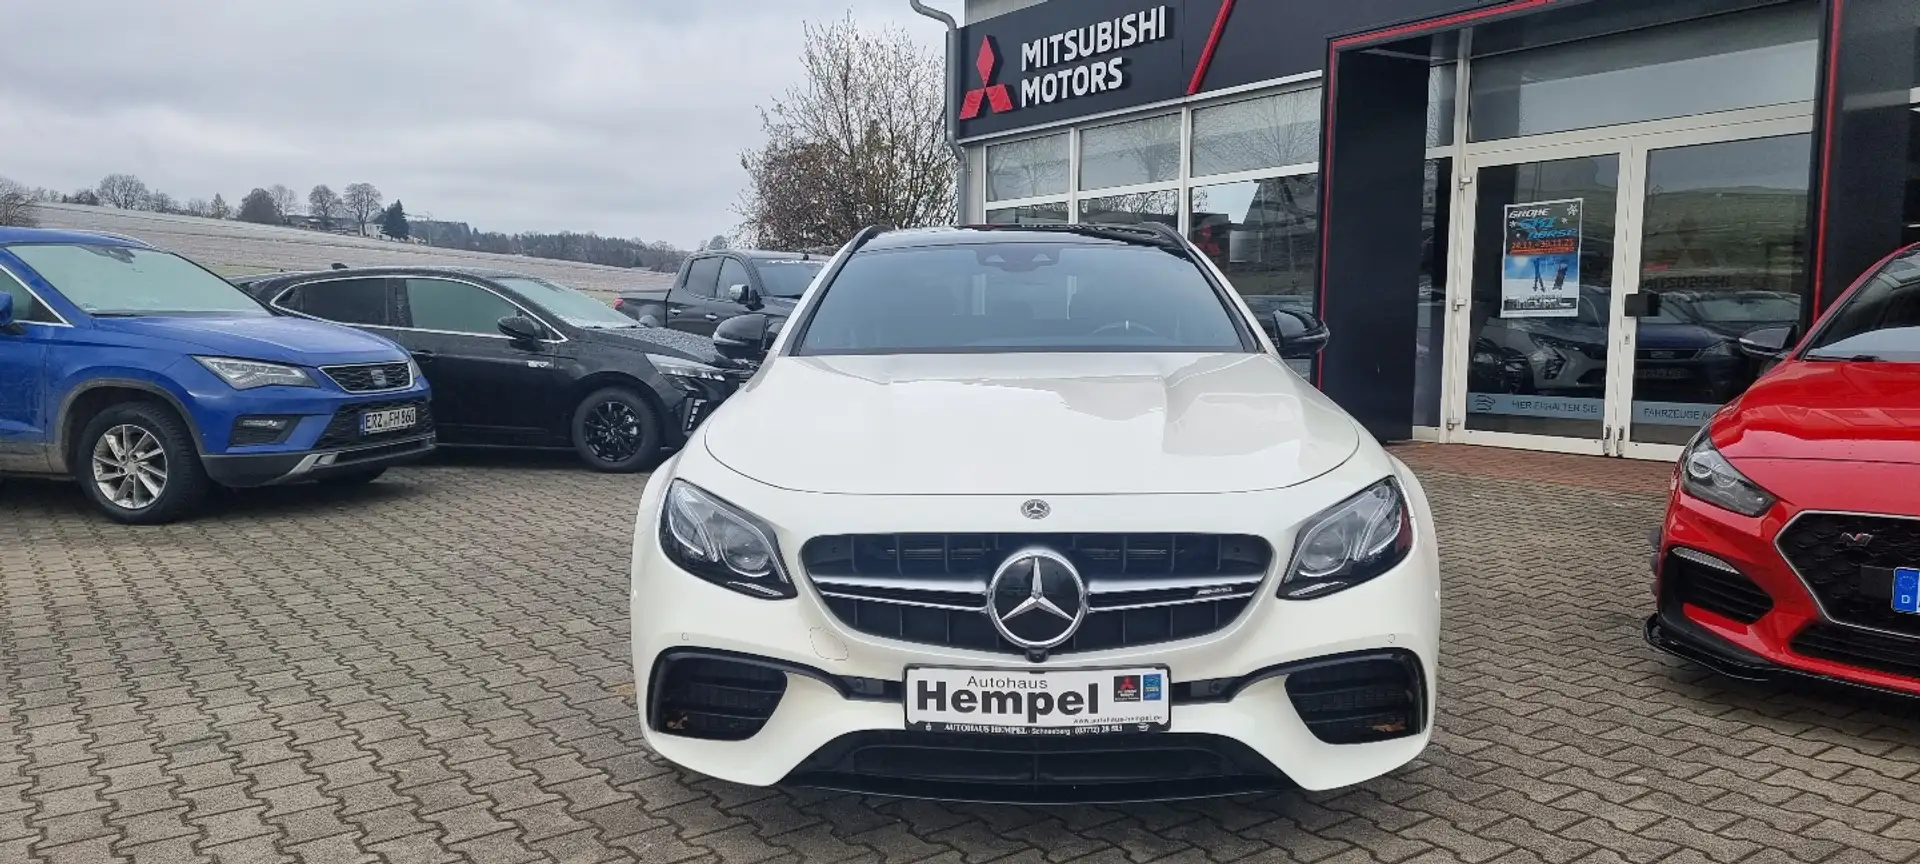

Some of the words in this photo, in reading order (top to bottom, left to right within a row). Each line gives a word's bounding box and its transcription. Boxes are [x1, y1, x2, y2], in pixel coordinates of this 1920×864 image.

[1021, 5, 1166, 72] MITSUBISHI
[1021, 57, 1123, 108] MOTORS
[1511, 400, 1532, 410] HIER
[1533, 401, 1580, 412] ERHALTEN
[1582, 404, 1598, 414] SIE
[1644, 408, 1700, 420] FAHRZEUGE
[366, 413, 382, 429] ERZ
[389, 411, 400, 425] FH
[1901, 594, 1911, 604] D
[967, 675, 1048, 690] Autohaus
[917, 680, 1099, 723] Hempel
[944, 723, 991, 733] AUTOHAUS
[991, 724, 1027, 735] HEMPEL
[1031, 727, 1071, 736] Schneeberg
